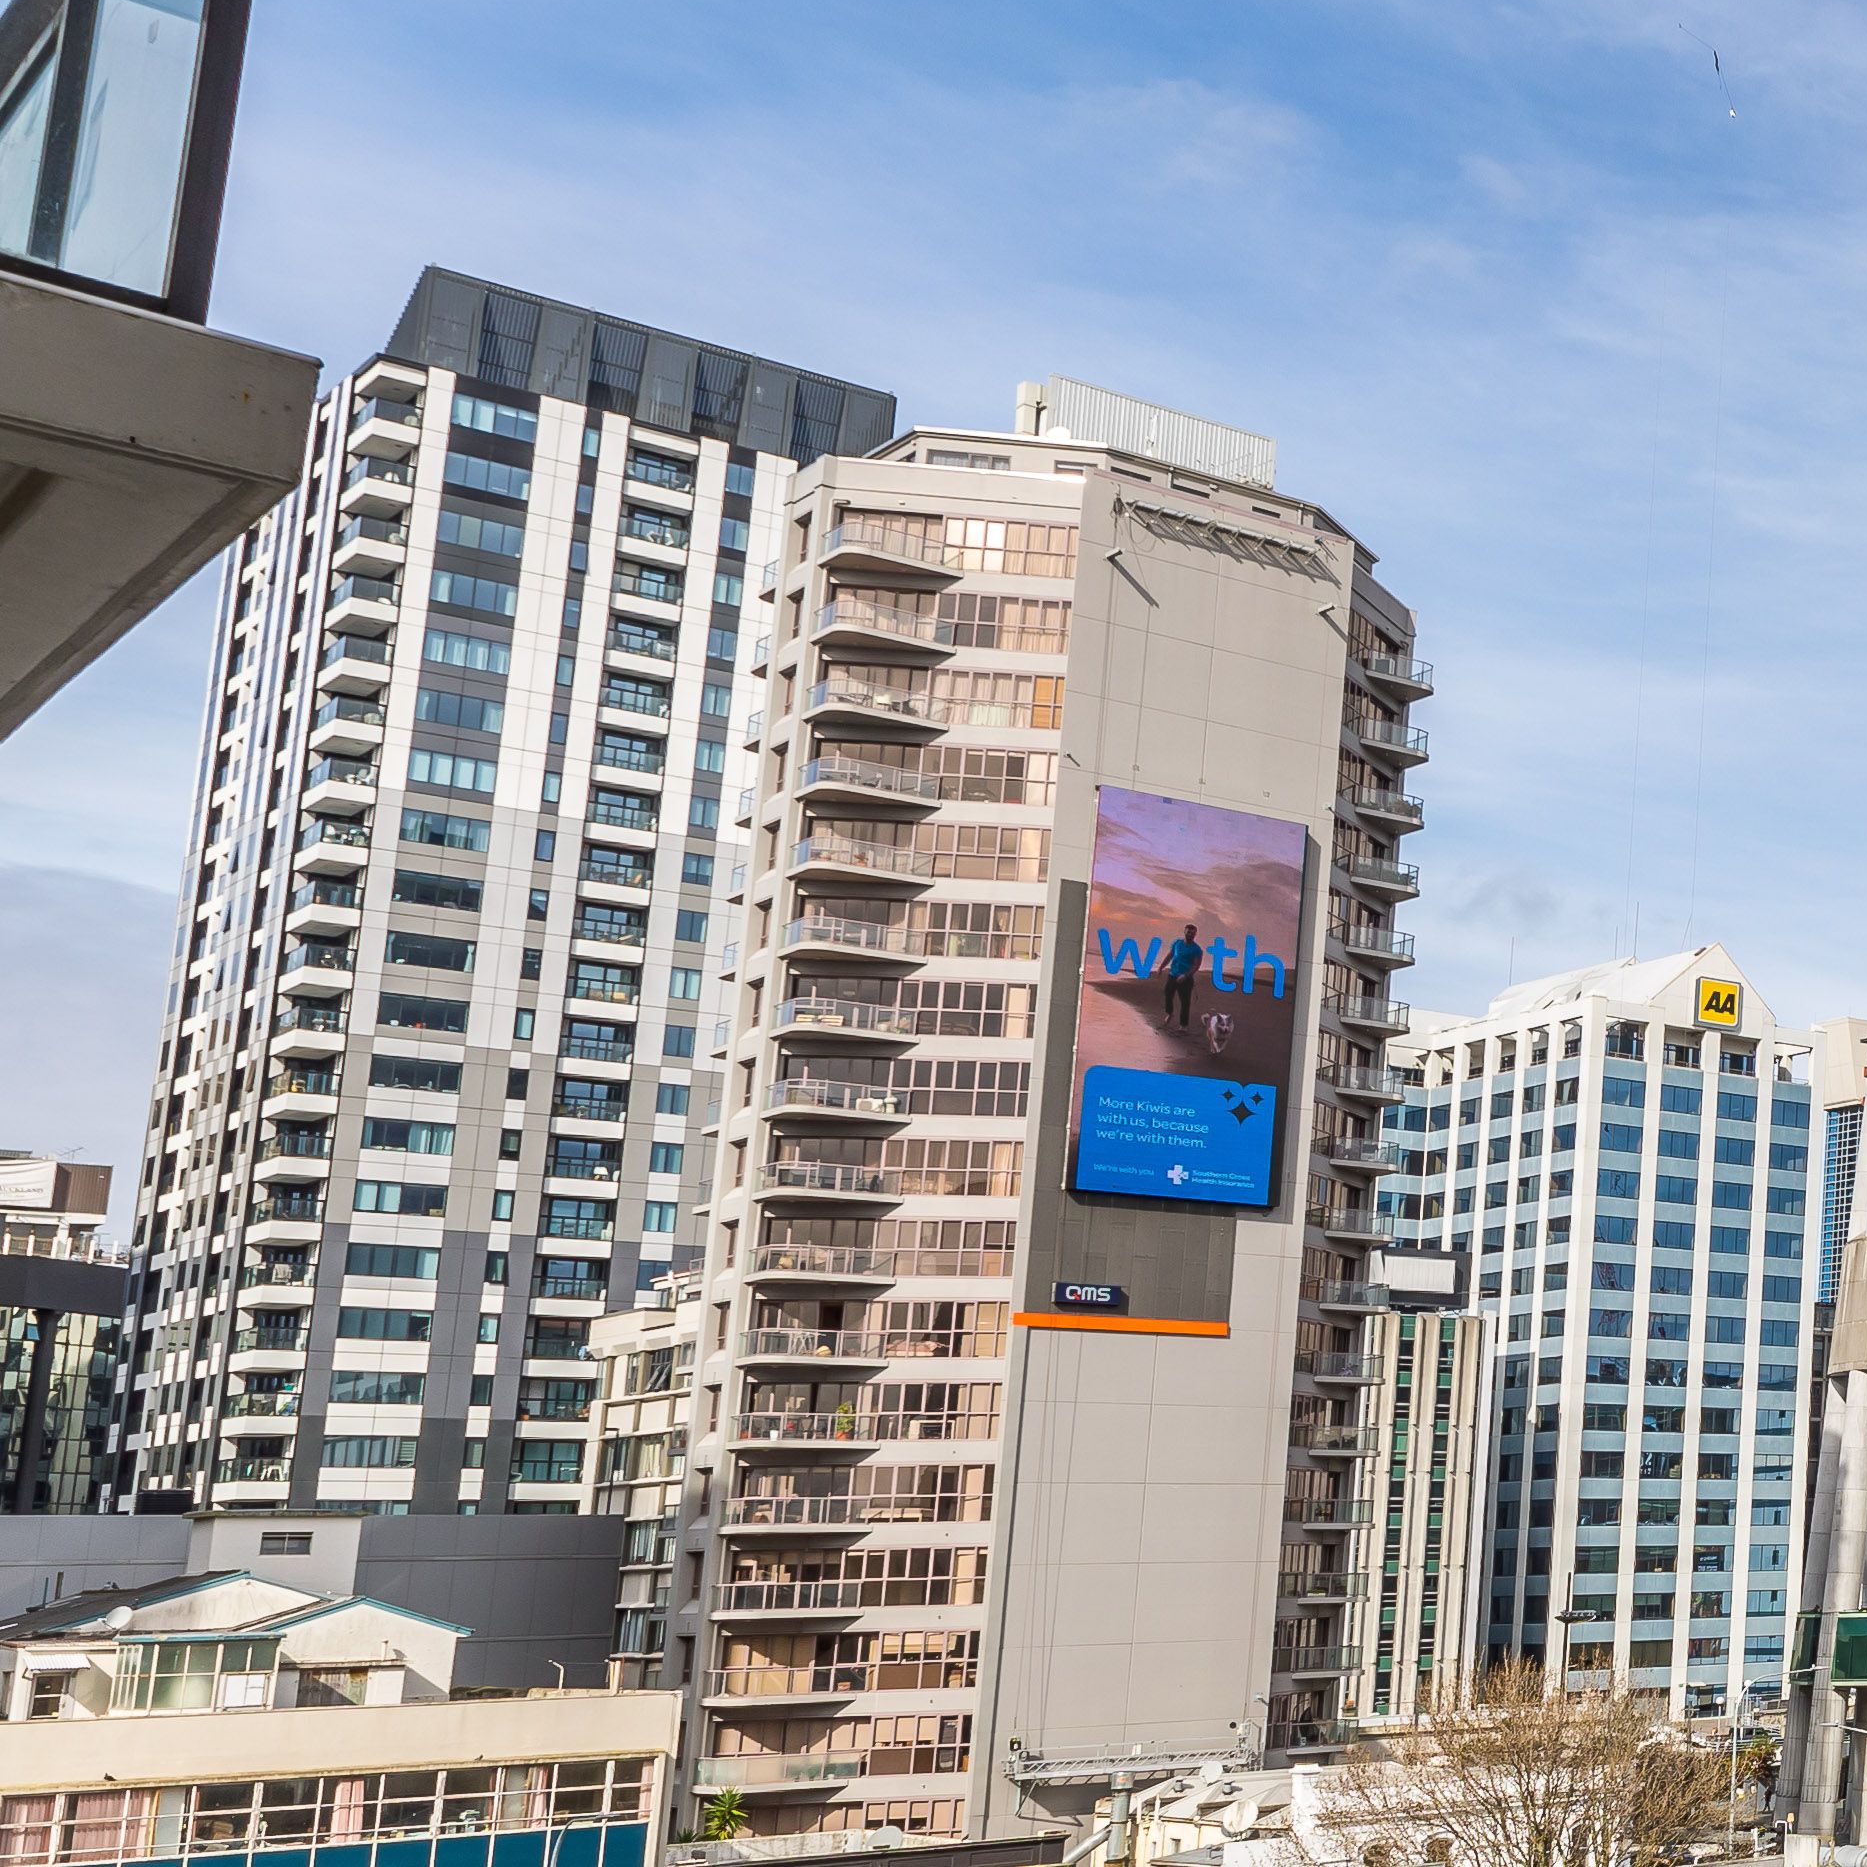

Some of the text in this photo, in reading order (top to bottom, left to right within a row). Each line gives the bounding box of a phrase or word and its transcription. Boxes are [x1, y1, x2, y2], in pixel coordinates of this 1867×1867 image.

[1097, 927, 1286, 1000] wth
[1703, 991, 1736, 1015] AA
[1098, 1096, 1196, 1117] More Kiwis are
[1097, 1113, 1209, 1134] with us, because
[1096, 1128, 1208, 1149] we're with them.
[1065, 1285, 1111, 1302] QMS
